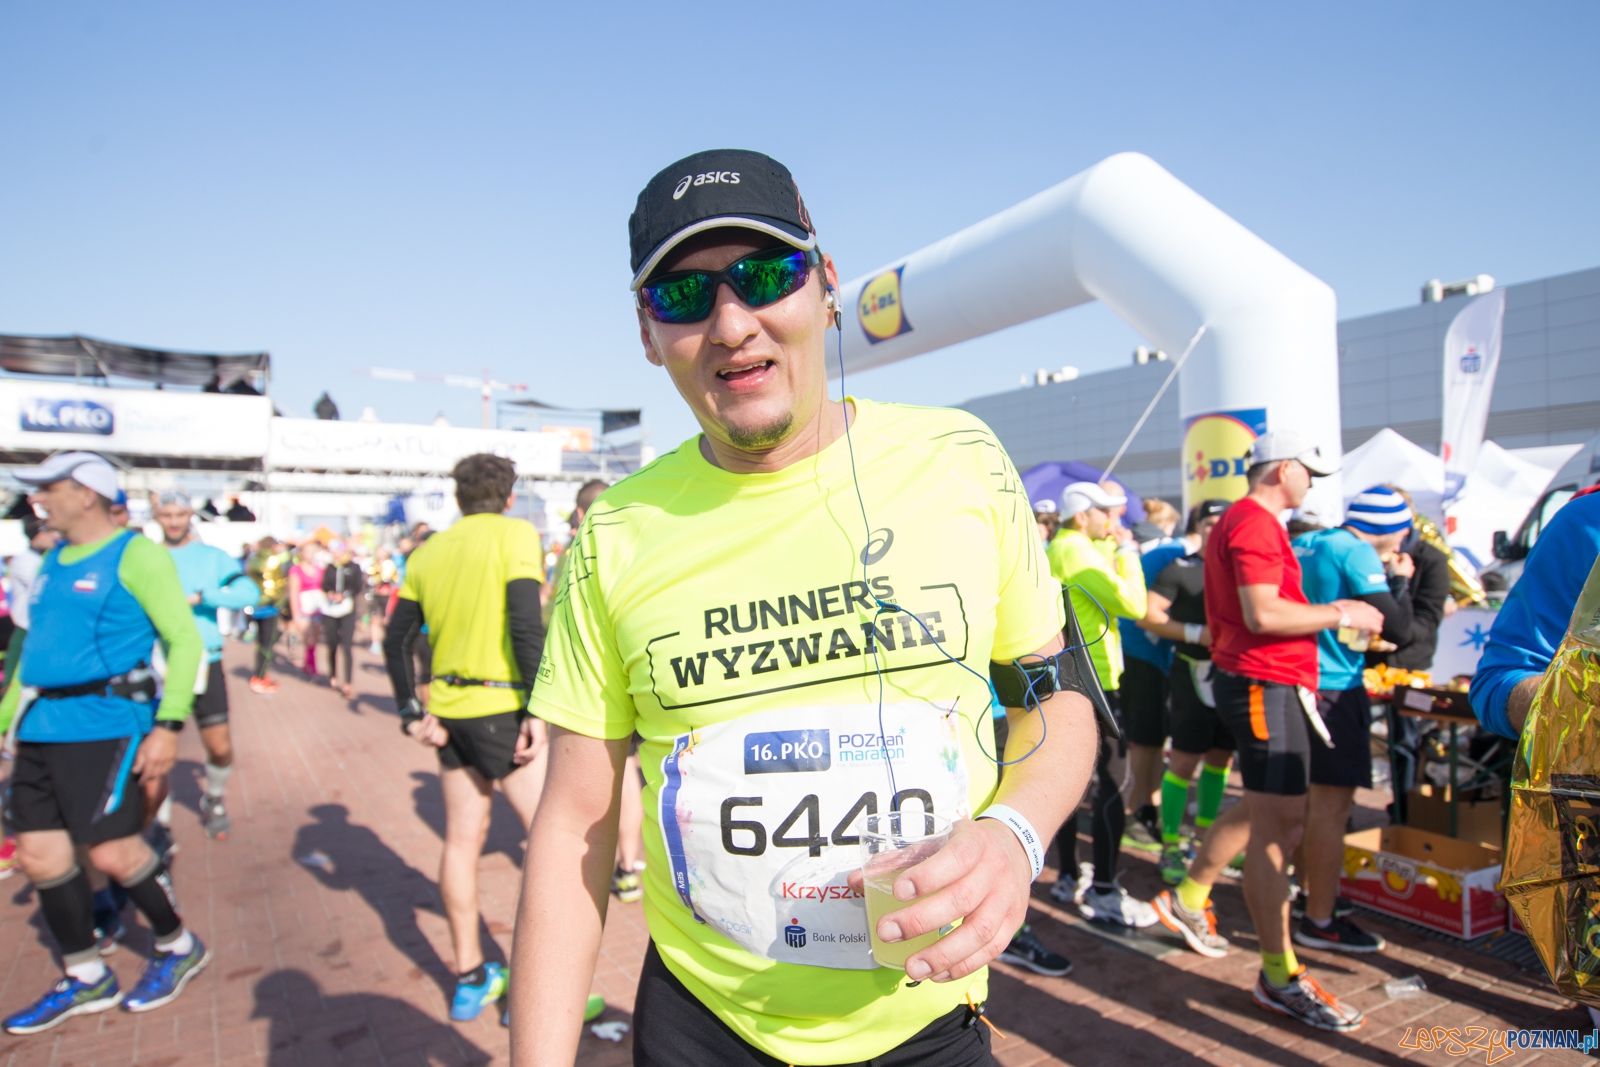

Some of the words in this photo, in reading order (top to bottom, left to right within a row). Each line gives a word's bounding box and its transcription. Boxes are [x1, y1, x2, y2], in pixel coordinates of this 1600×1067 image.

[693, 171, 740, 187] asics
[59, 405, 110, 429] PKO
[704, 576, 895, 639] RUNNER'S
[669, 611, 947, 689] WYZWANIE
[750, 743, 778, 761] 16.
[781, 741, 823, 760] PKO
[839, 746, 905, 762] maraton
[720, 788, 935, 857] 6440
[782, 882, 865, 904] Krzysz
[812, 932, 836, 943] Bank
[839, 932, 866, 944] Polski
